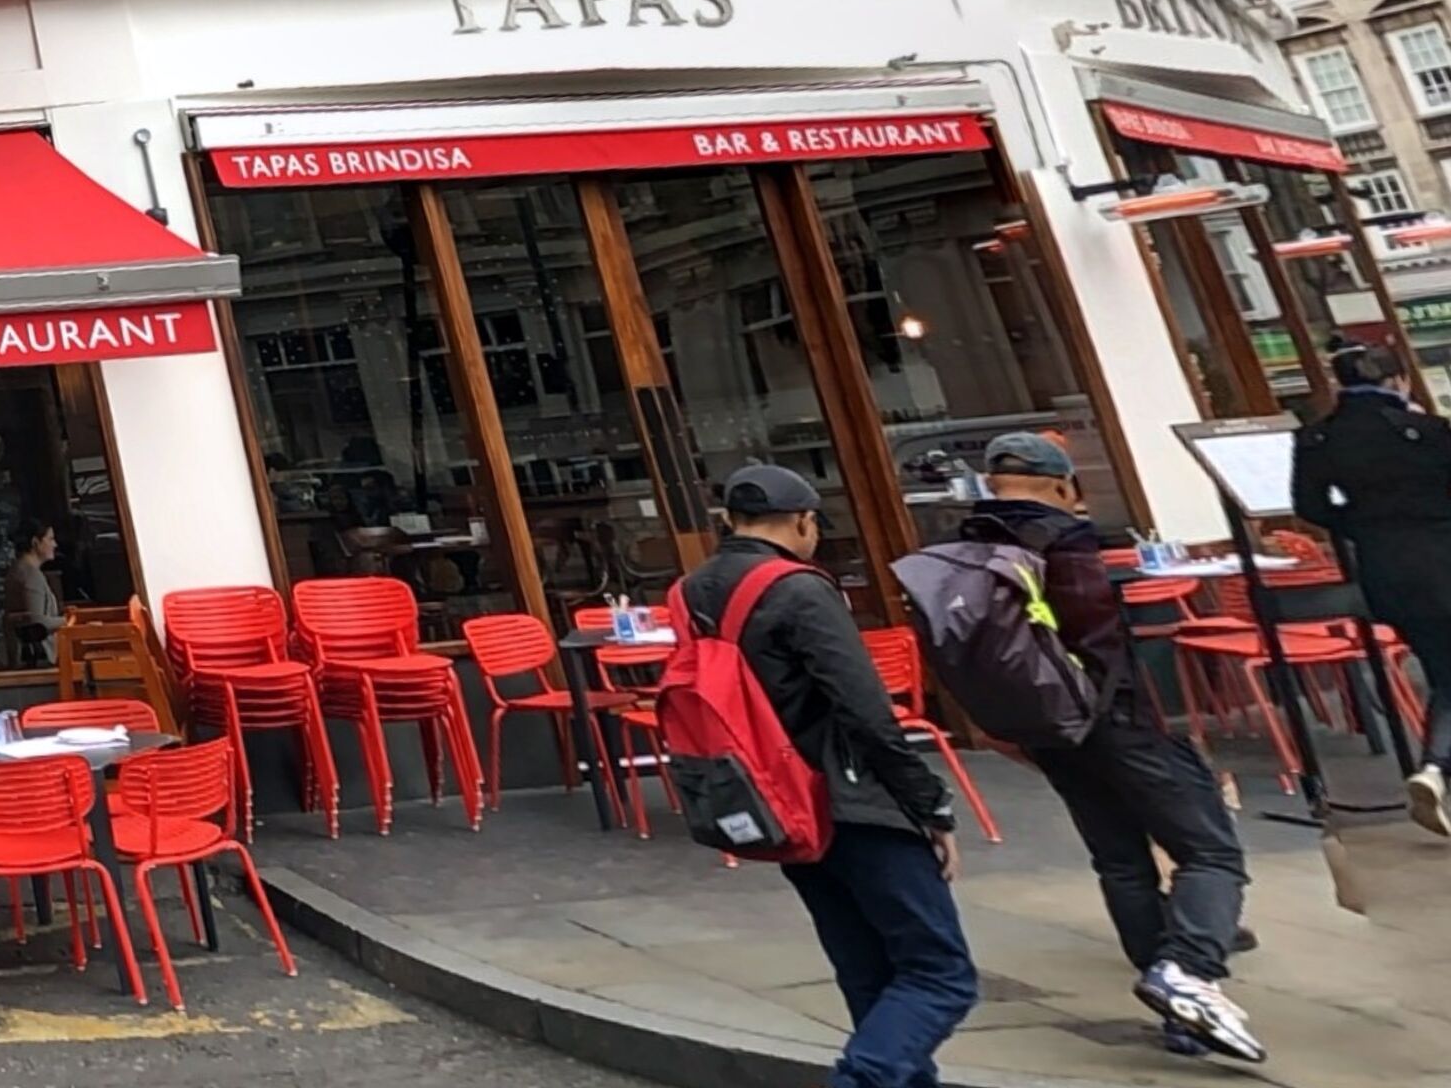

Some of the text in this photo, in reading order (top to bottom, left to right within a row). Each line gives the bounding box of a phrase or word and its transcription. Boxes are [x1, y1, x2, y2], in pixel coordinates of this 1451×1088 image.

[693, 121, 964, 157] BAR & RESTAURANT
[231, 146, 472, 180] TAPAS BRINDISA
